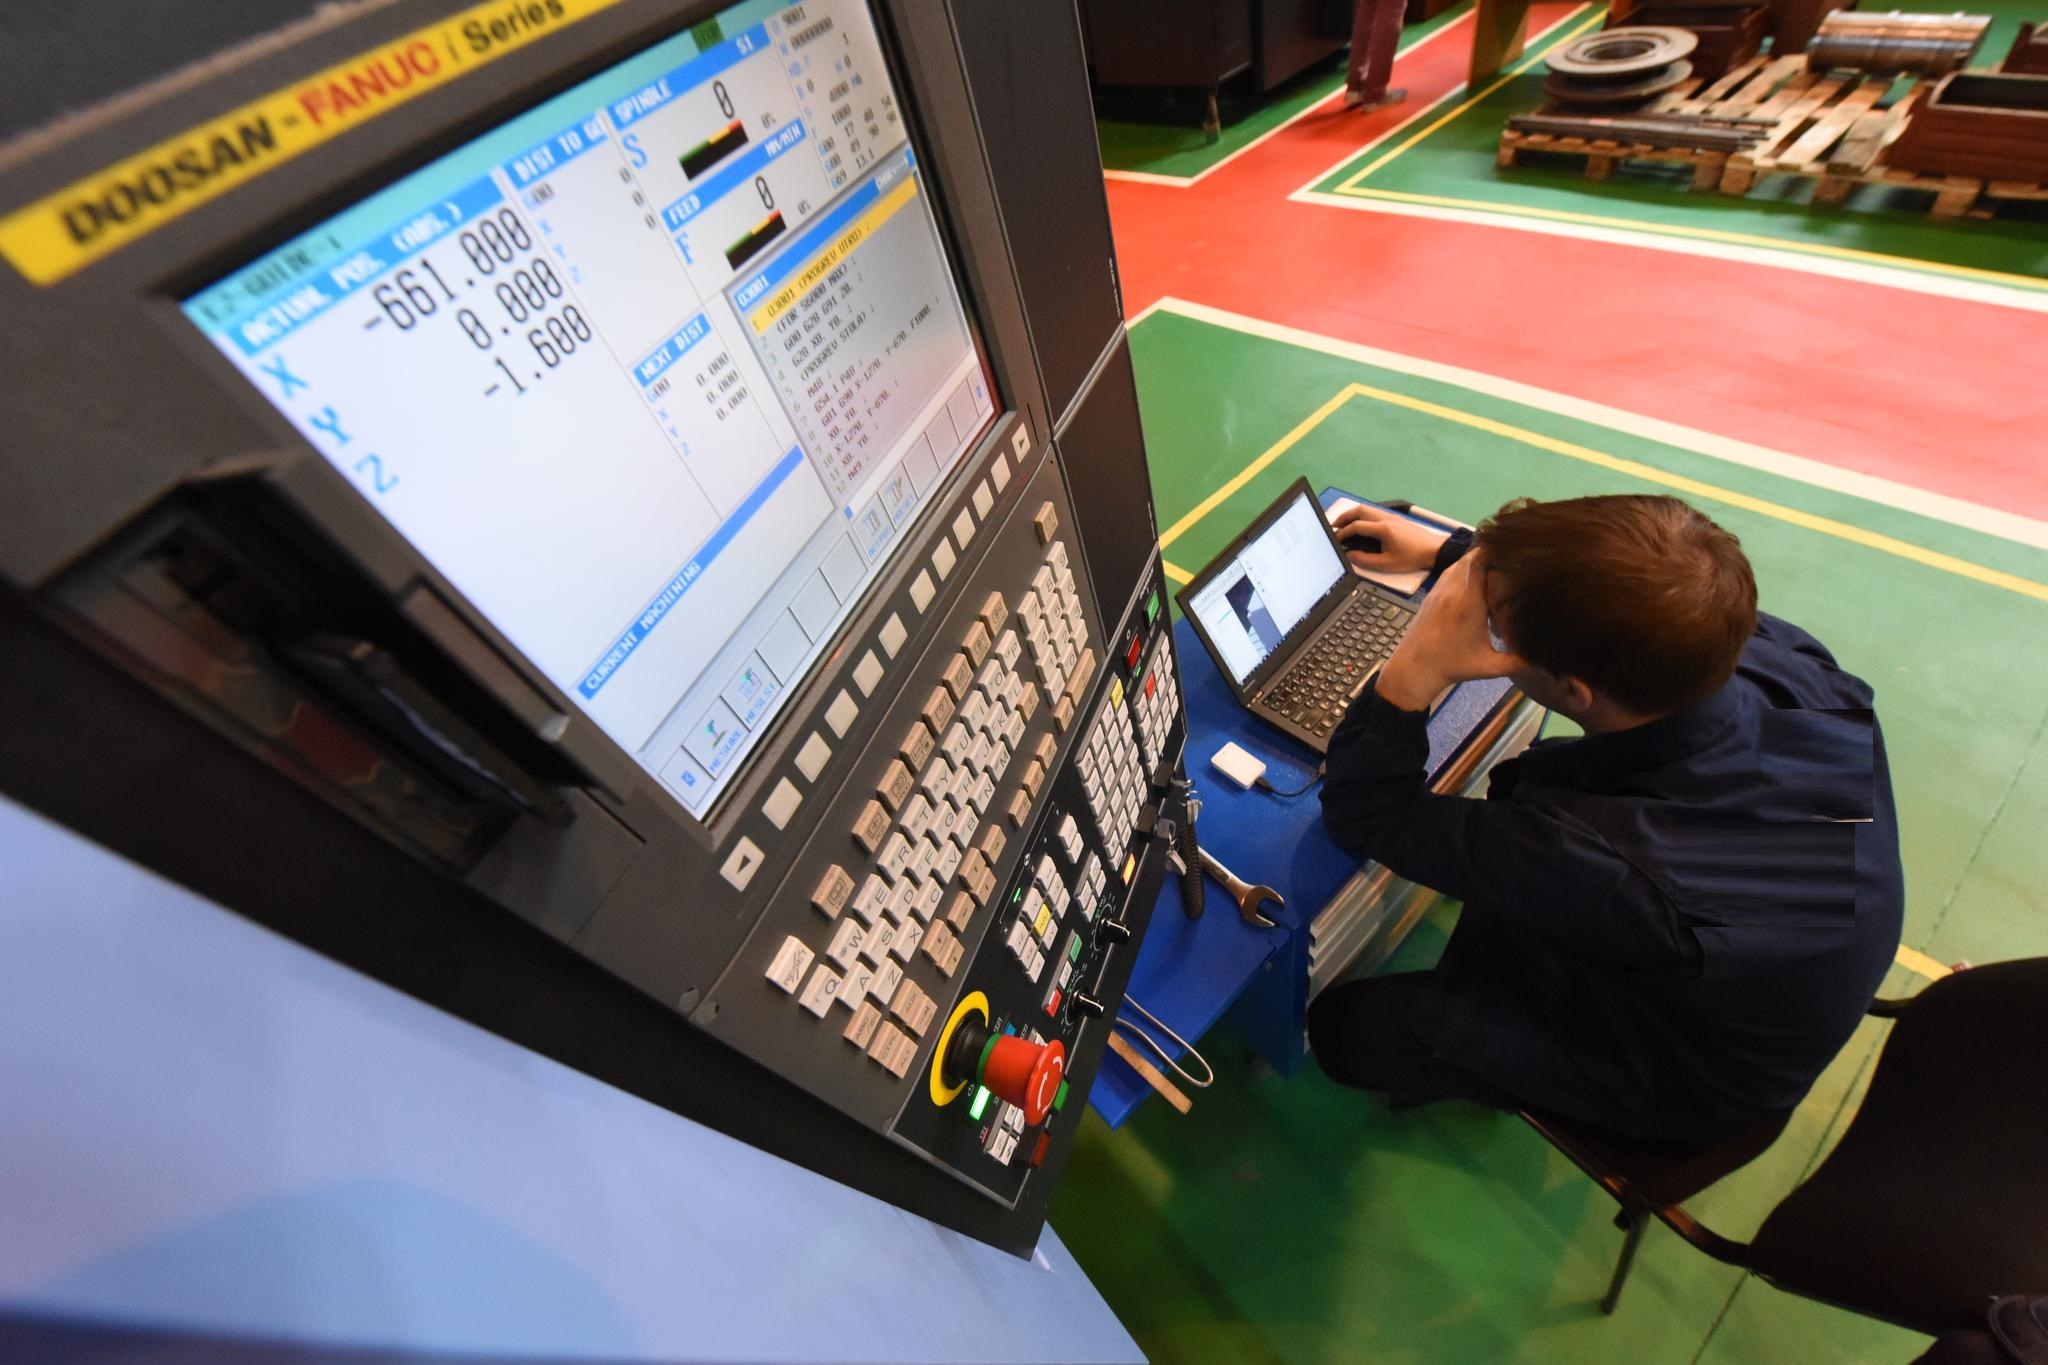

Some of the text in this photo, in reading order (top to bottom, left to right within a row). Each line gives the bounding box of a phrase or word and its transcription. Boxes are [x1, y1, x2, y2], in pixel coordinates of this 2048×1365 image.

[615, 81, 670, 121] SPINDLE
[736, 33, 753, 54] S1
[58, 116, 279, 245] DOOSAN
[297, 39, 442, 126] FANUC
[464, 0, 565, 55] Series
[622, 80, 734, 168] S 0
[514, 147, 557, 181] DIST
[559, 128, 586, 154] TO
[669, 191, 702, 226] FEED
[675, 176, 774, 264] F 0
[261, 357, 307, 397] X
[365, 208, 532, 330] -661.000
[822, 296, 837, 314] G91
[238, 283, 325, 348] ACTUAL
[310, 258, 562, 443] Y 0.000
[641, 317, 705, 381] NEXT DIST
[356, 304, 591, 493] Z -1.600
[1059, 553, 1066, 568] 9
[1046, 577, 1053, 594] 8
[1067, 580, 1073, 595] 6
[1032, 602, 1039, 617] 7
[583, 562, 700, 692] CURRENT MACHINING
[1011, 642, 1018, 657] P
[1069, 653, 1075, 667] 0
[1013, 684, 1021, 697] L
[997, 713, 1005, 728] K
[959, 734, 968, 750] U
[982, 743, 989, 758] J
[1000, 750, 1008, 767] M
[940, 769, 949, 786] Y
[963, 777, 972, 793] H
[984, 783, 992, 798] N
[919, 806, 929, 822] T
[944, 812, 954, 827] G
[967, 815, 975, 831] B
[898, 846, 909, 863] R
[924, 848, 934, 865] F
[948, 850, 957, 866] V
[875, 887, 887, 904] E
[903, 888, 913, 905] D
[930, 888, 940, 904] C
[848, 929, 863, 949] W
[881, 929, 893, 946] S
[909, 928, 920, 944] X
[824, 976, 839, 995] Q
[858, 973, 870, 991] A
[888, 968, 899, 986] Z
[905, 992, 917, 1014] AUX
